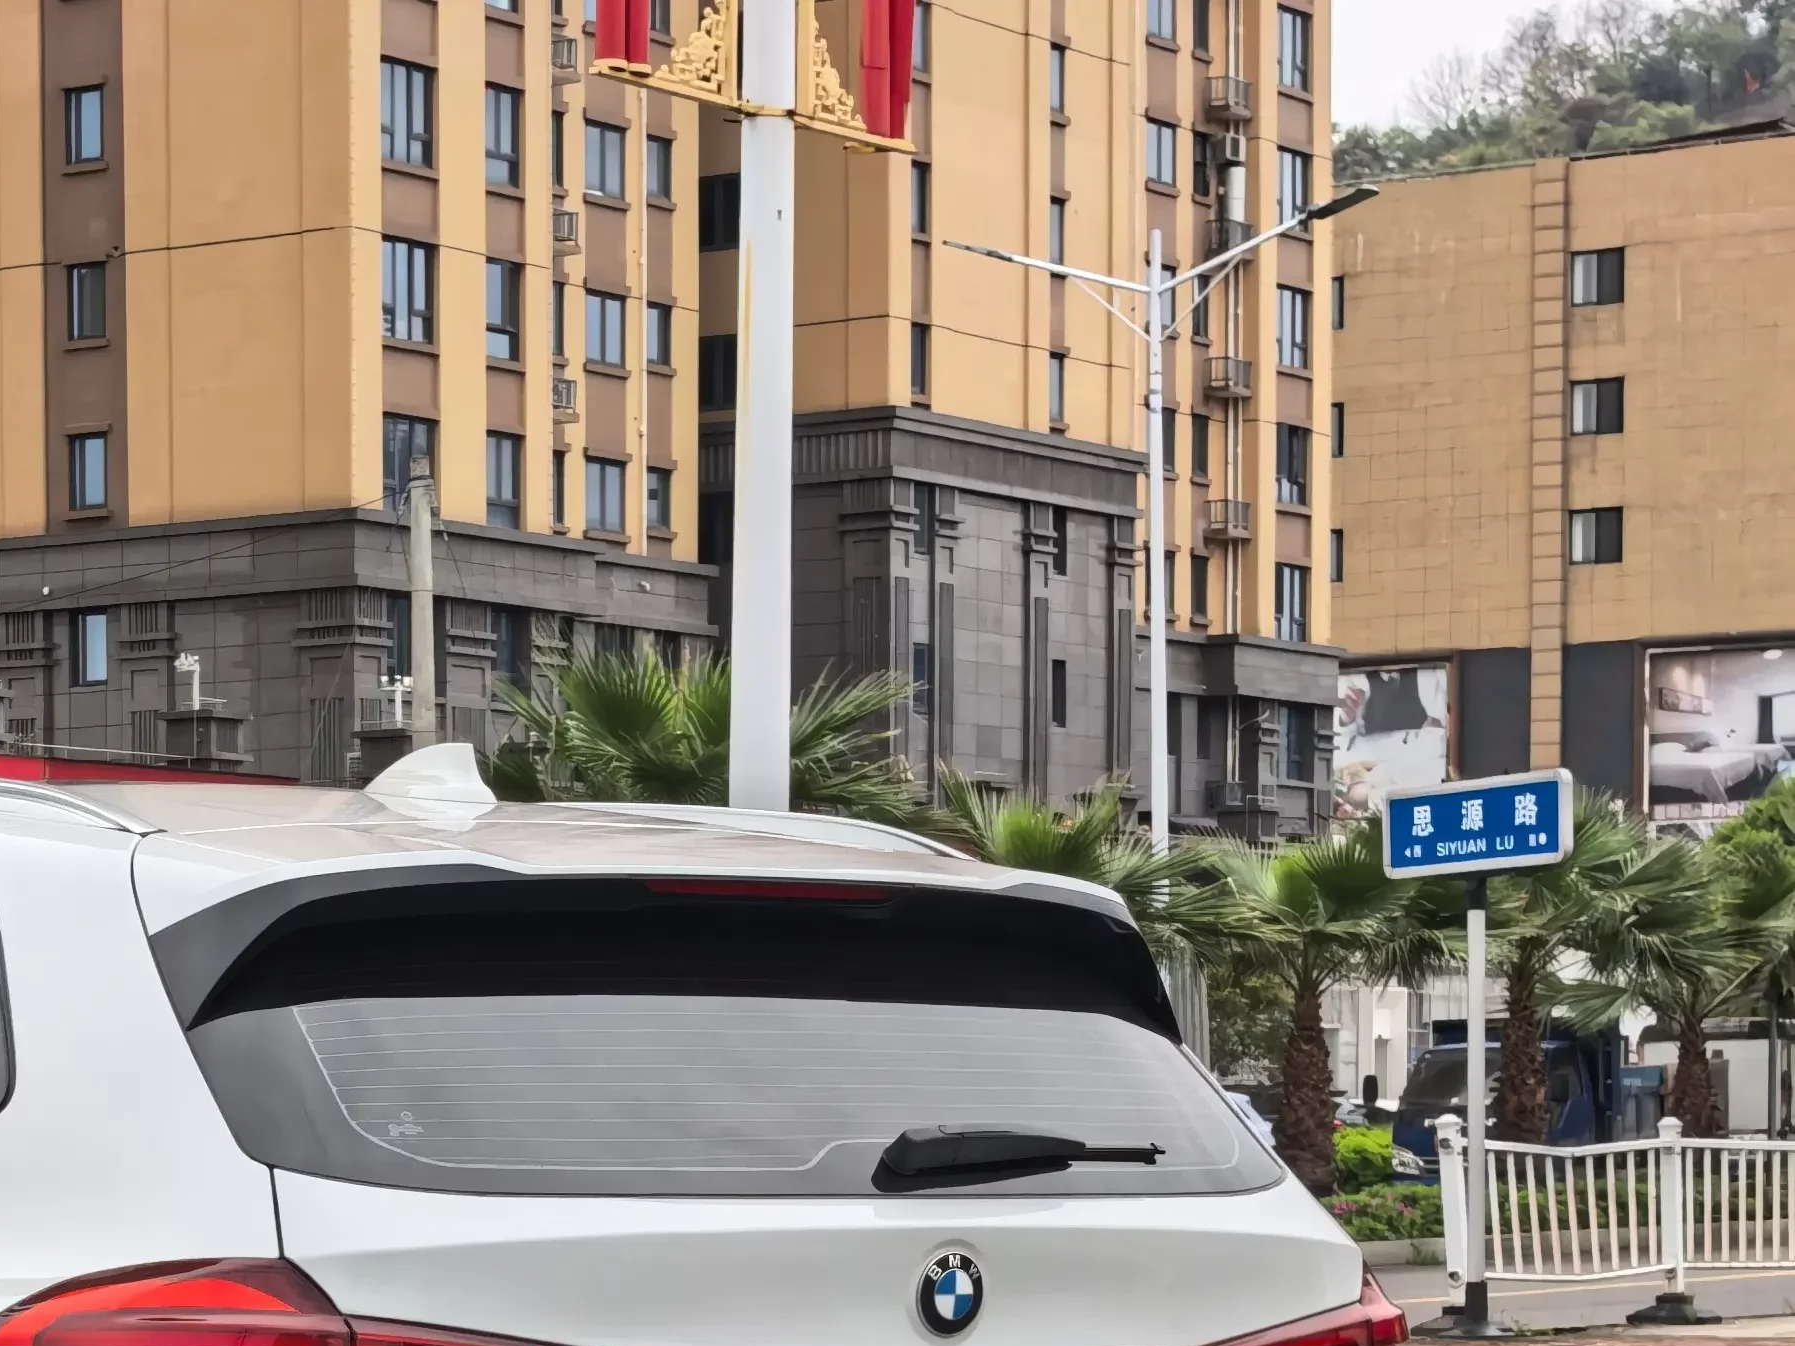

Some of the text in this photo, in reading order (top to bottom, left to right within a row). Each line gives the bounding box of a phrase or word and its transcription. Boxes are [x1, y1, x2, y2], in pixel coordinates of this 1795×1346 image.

[1412, 792, 1538, 837] 思源路
[1436, 838, 1487, 857] SIYUAN
[1496, 835, 1514, 850] LU
